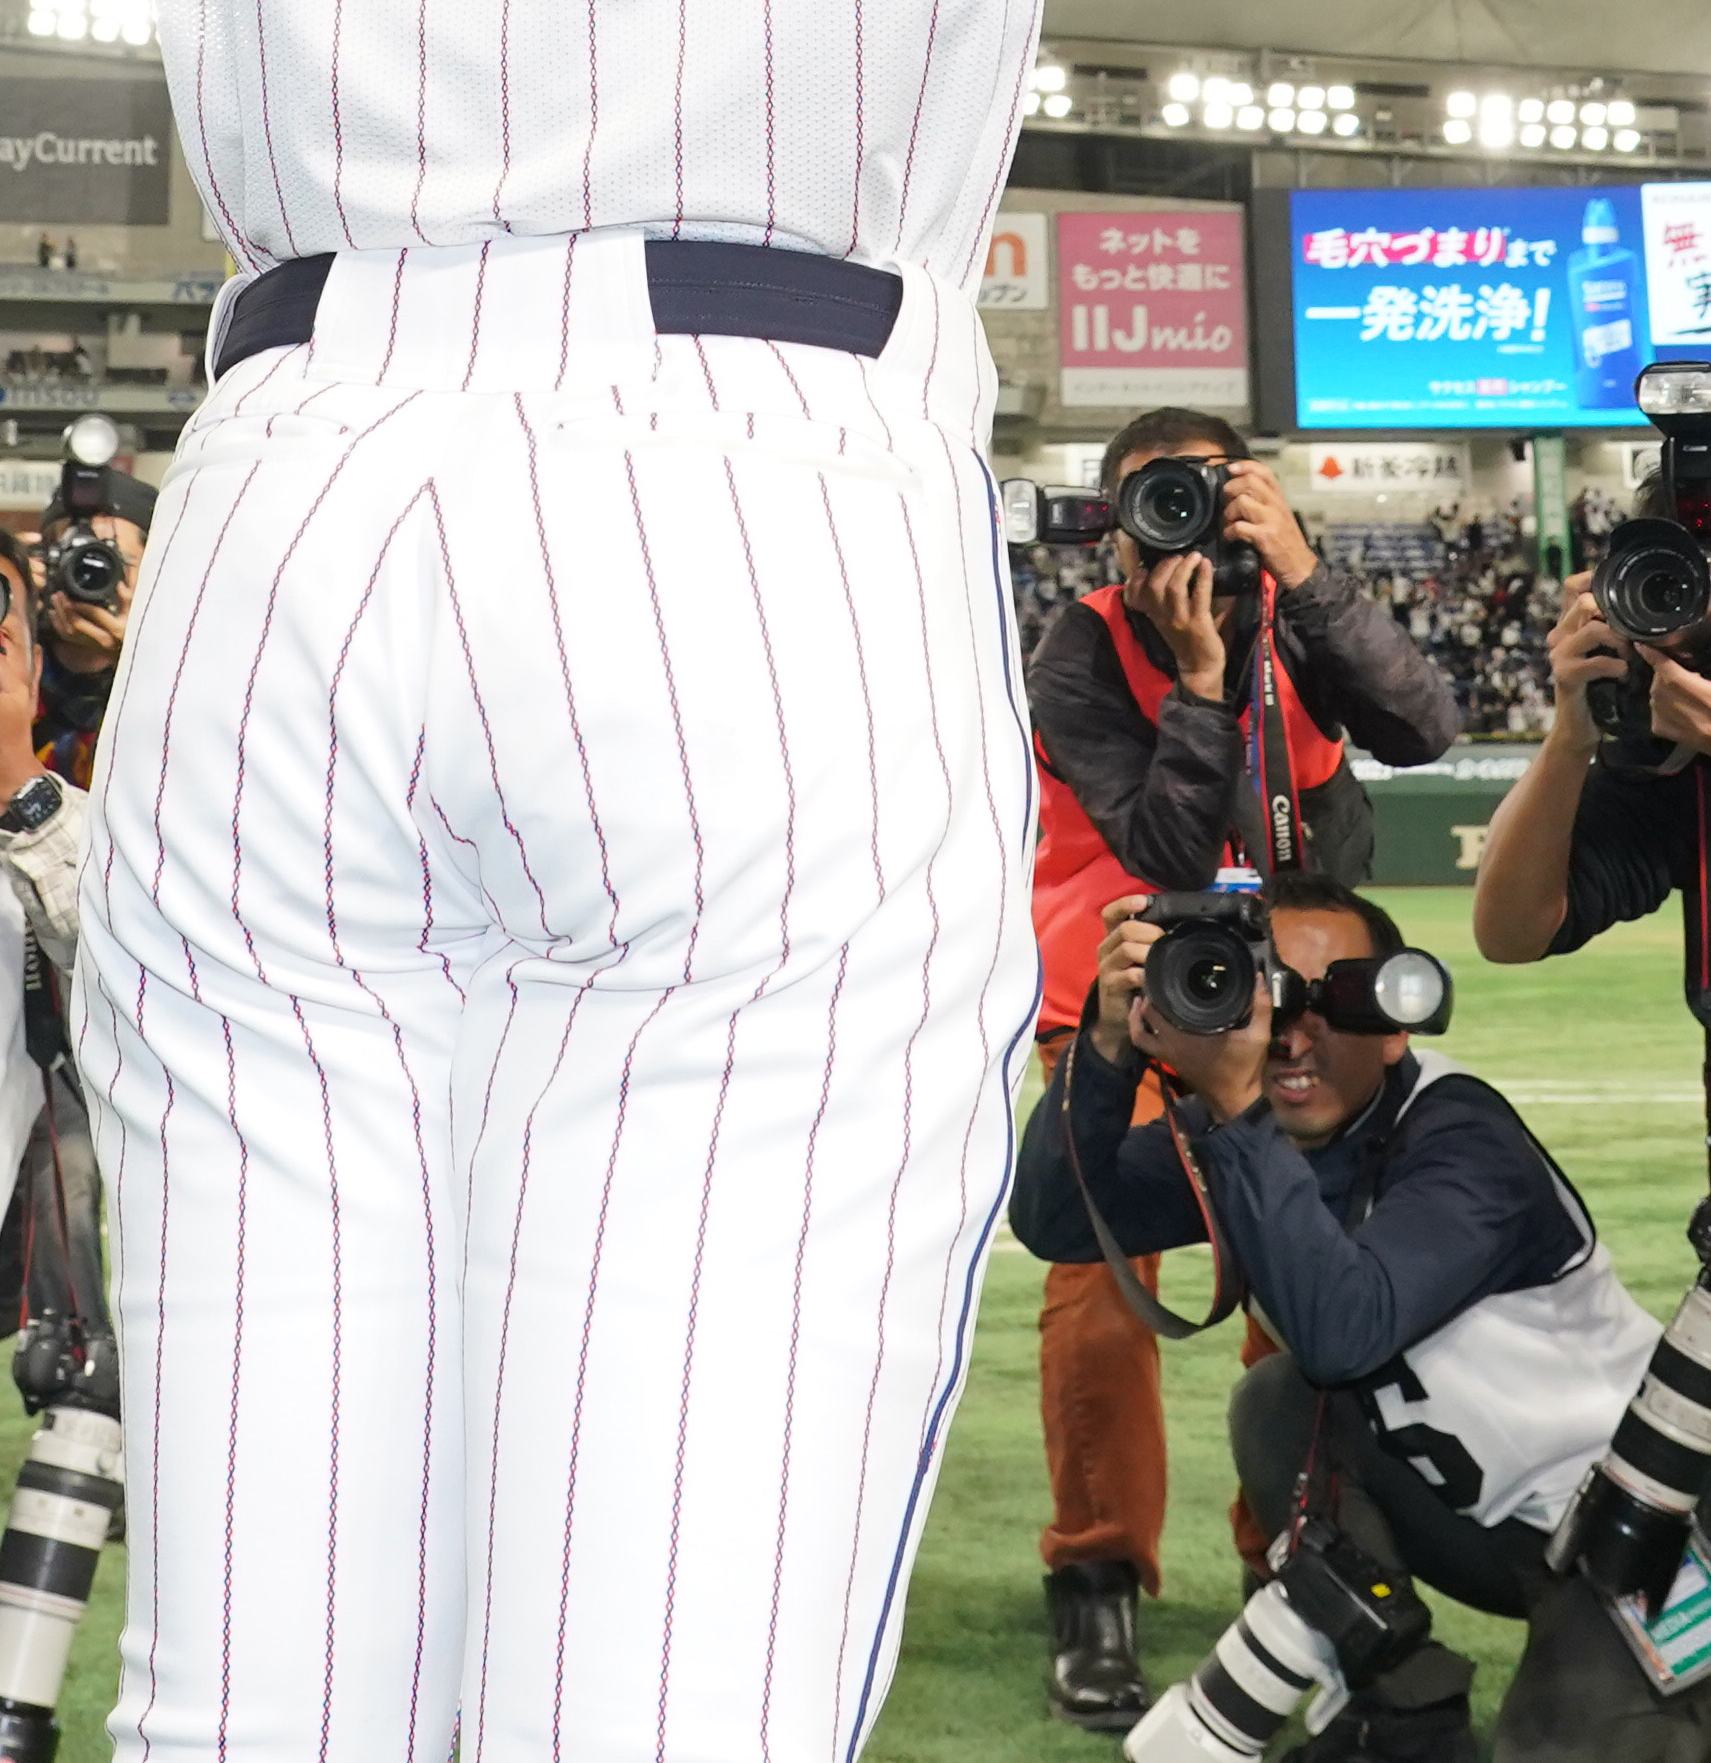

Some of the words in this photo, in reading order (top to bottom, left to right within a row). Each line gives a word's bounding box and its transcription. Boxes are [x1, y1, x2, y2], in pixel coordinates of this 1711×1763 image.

[1099, 226, 1202, 255] ネットを
[1071, 262, 1232, 292] もっと快適に
[1305, 283, 1552, 343] 一発洗浄!
[1271, 794, 1292, 863] Canon
